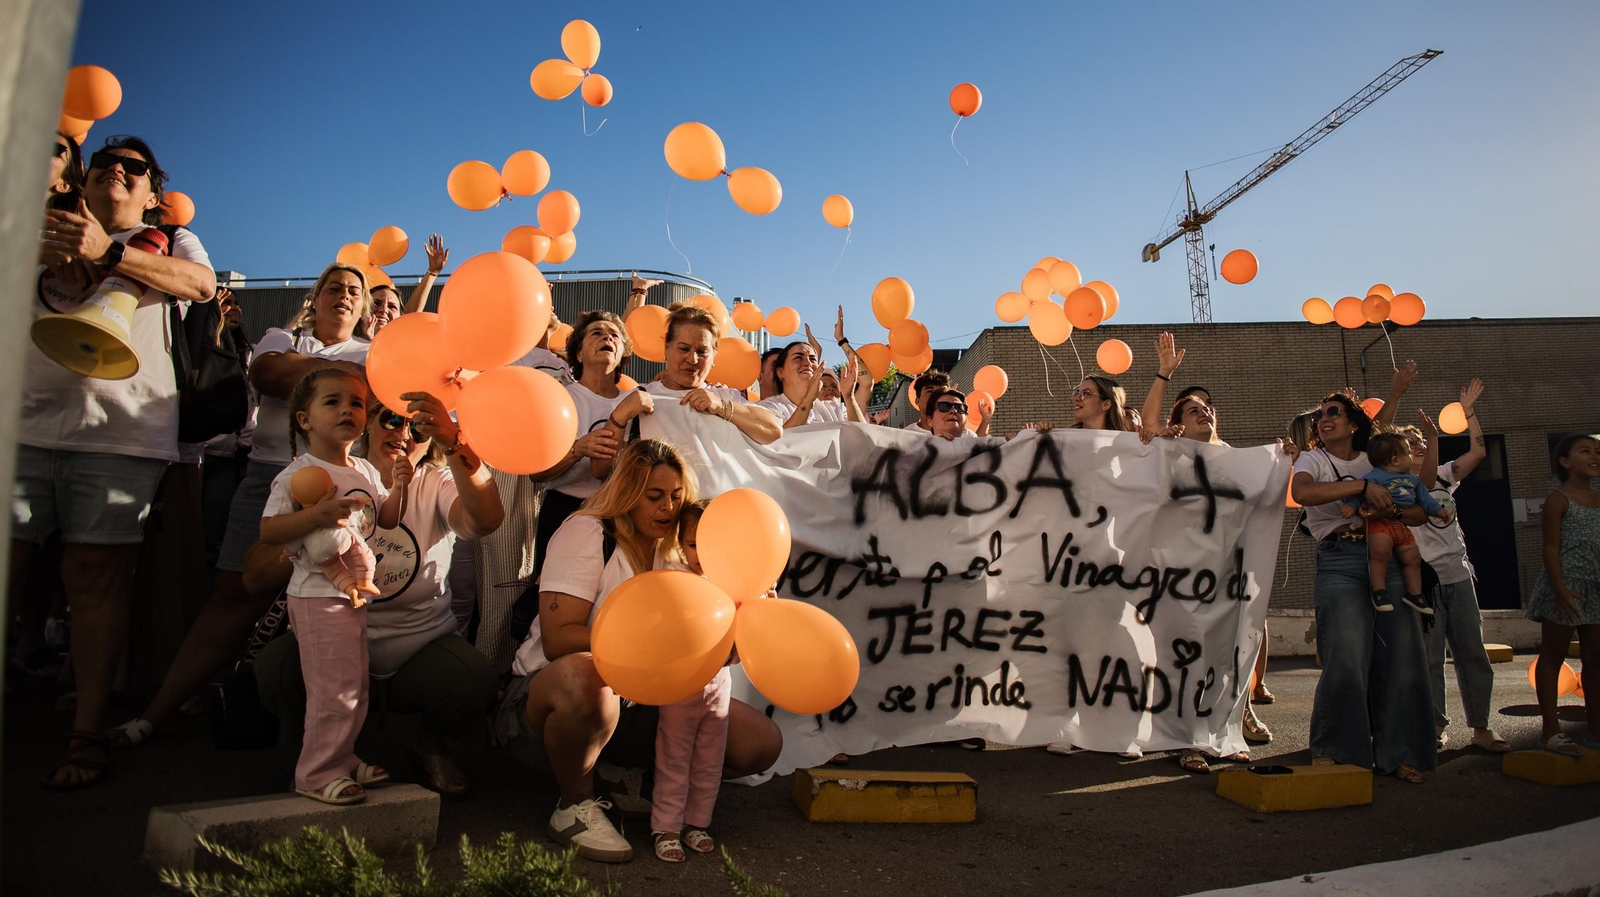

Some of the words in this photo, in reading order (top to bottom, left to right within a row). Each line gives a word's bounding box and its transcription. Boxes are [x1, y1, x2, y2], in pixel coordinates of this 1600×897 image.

[851, 433, 1108, 528] ALBA,
[388, 542, 404, 552] que
[383, 569, 412, 587] Jerez
[1041, 531, 1217, 626] Vinagre
[867, 604, 1048, 665] JEREZ
